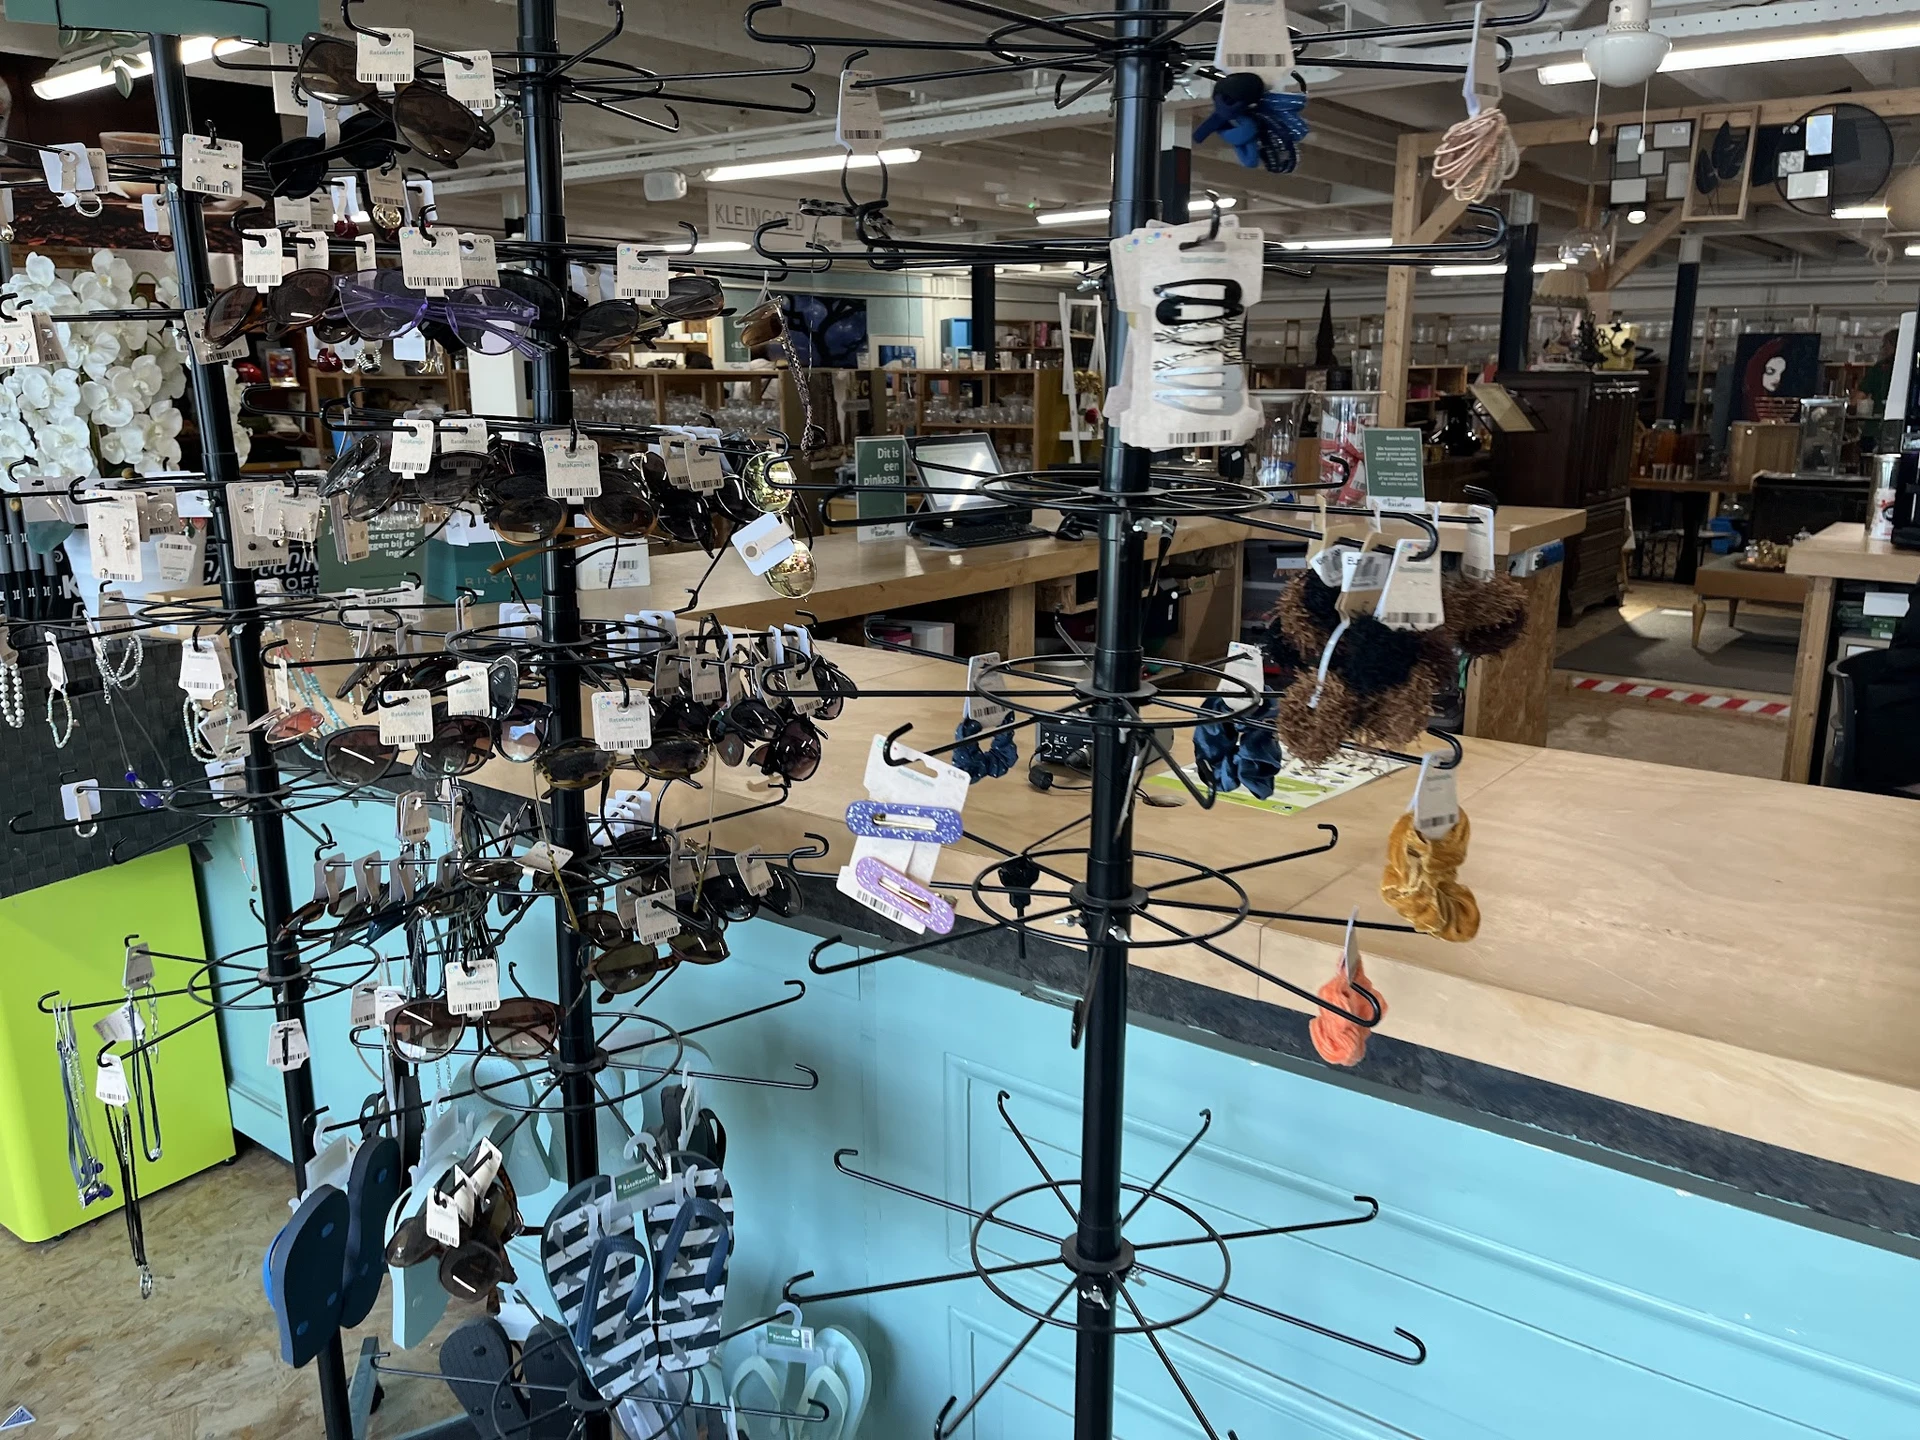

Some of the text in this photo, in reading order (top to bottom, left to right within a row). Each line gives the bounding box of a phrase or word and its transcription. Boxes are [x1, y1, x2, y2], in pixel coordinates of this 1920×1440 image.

[715, 203, 805, 231] KLEINGOED
[877, 447, 900, 460] Dit is
[883, 462, 900, 472] een
[863, 474, 900, 486] pinkassa
[381, 532, 405, 540] terug
[368, 539, 415, 551] ggen bij de
[386, 550, 415, 559] ingag
[367, 597, 398, 605] taPlan
[623, 1174, 656, 1191] RataKansjes
